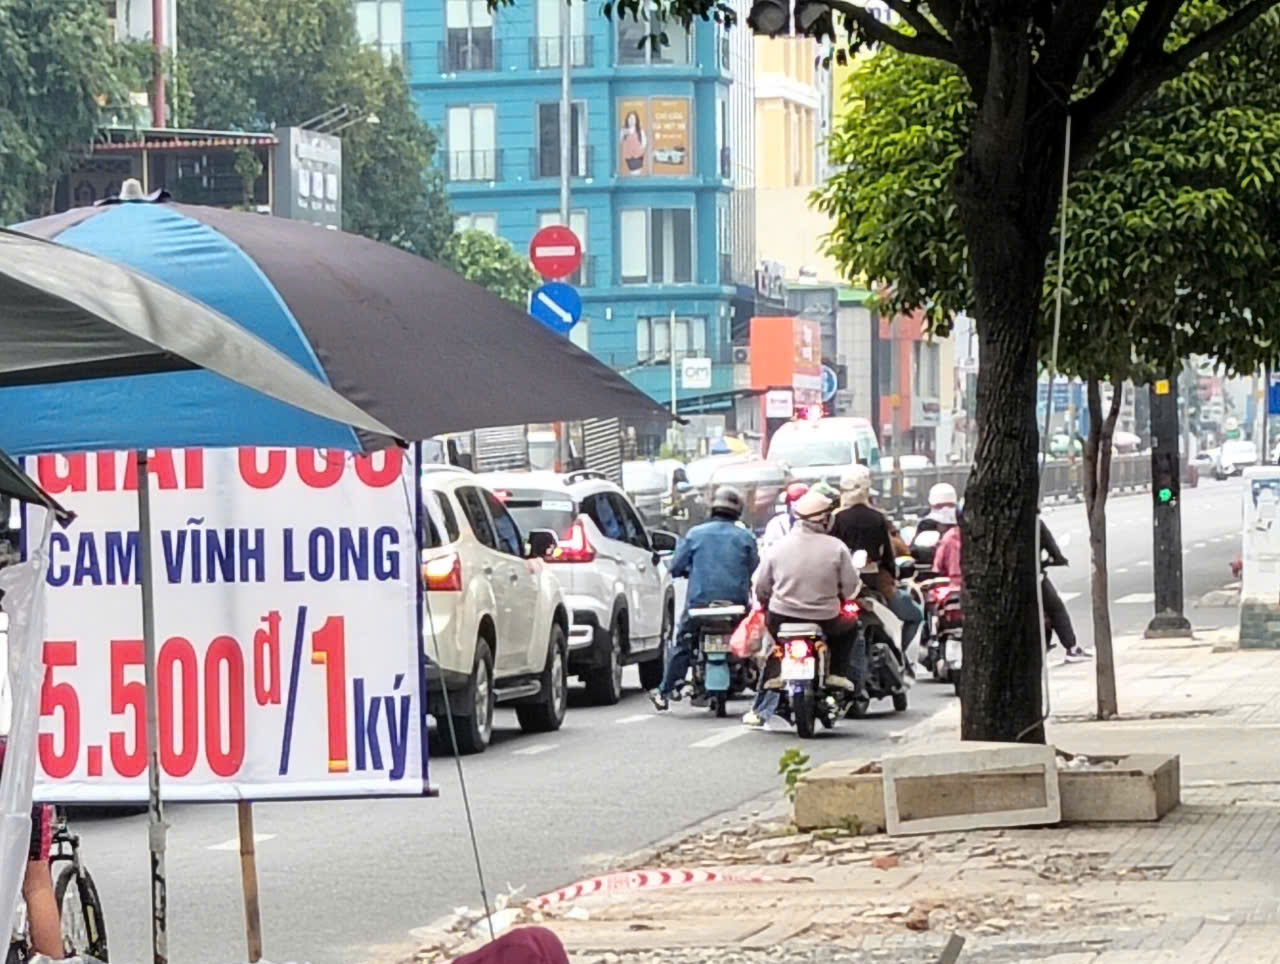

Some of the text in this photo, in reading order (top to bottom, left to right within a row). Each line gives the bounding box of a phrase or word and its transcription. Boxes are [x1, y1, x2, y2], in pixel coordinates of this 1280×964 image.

[46, 517, 400, 587] CAM VĨNH LONG
